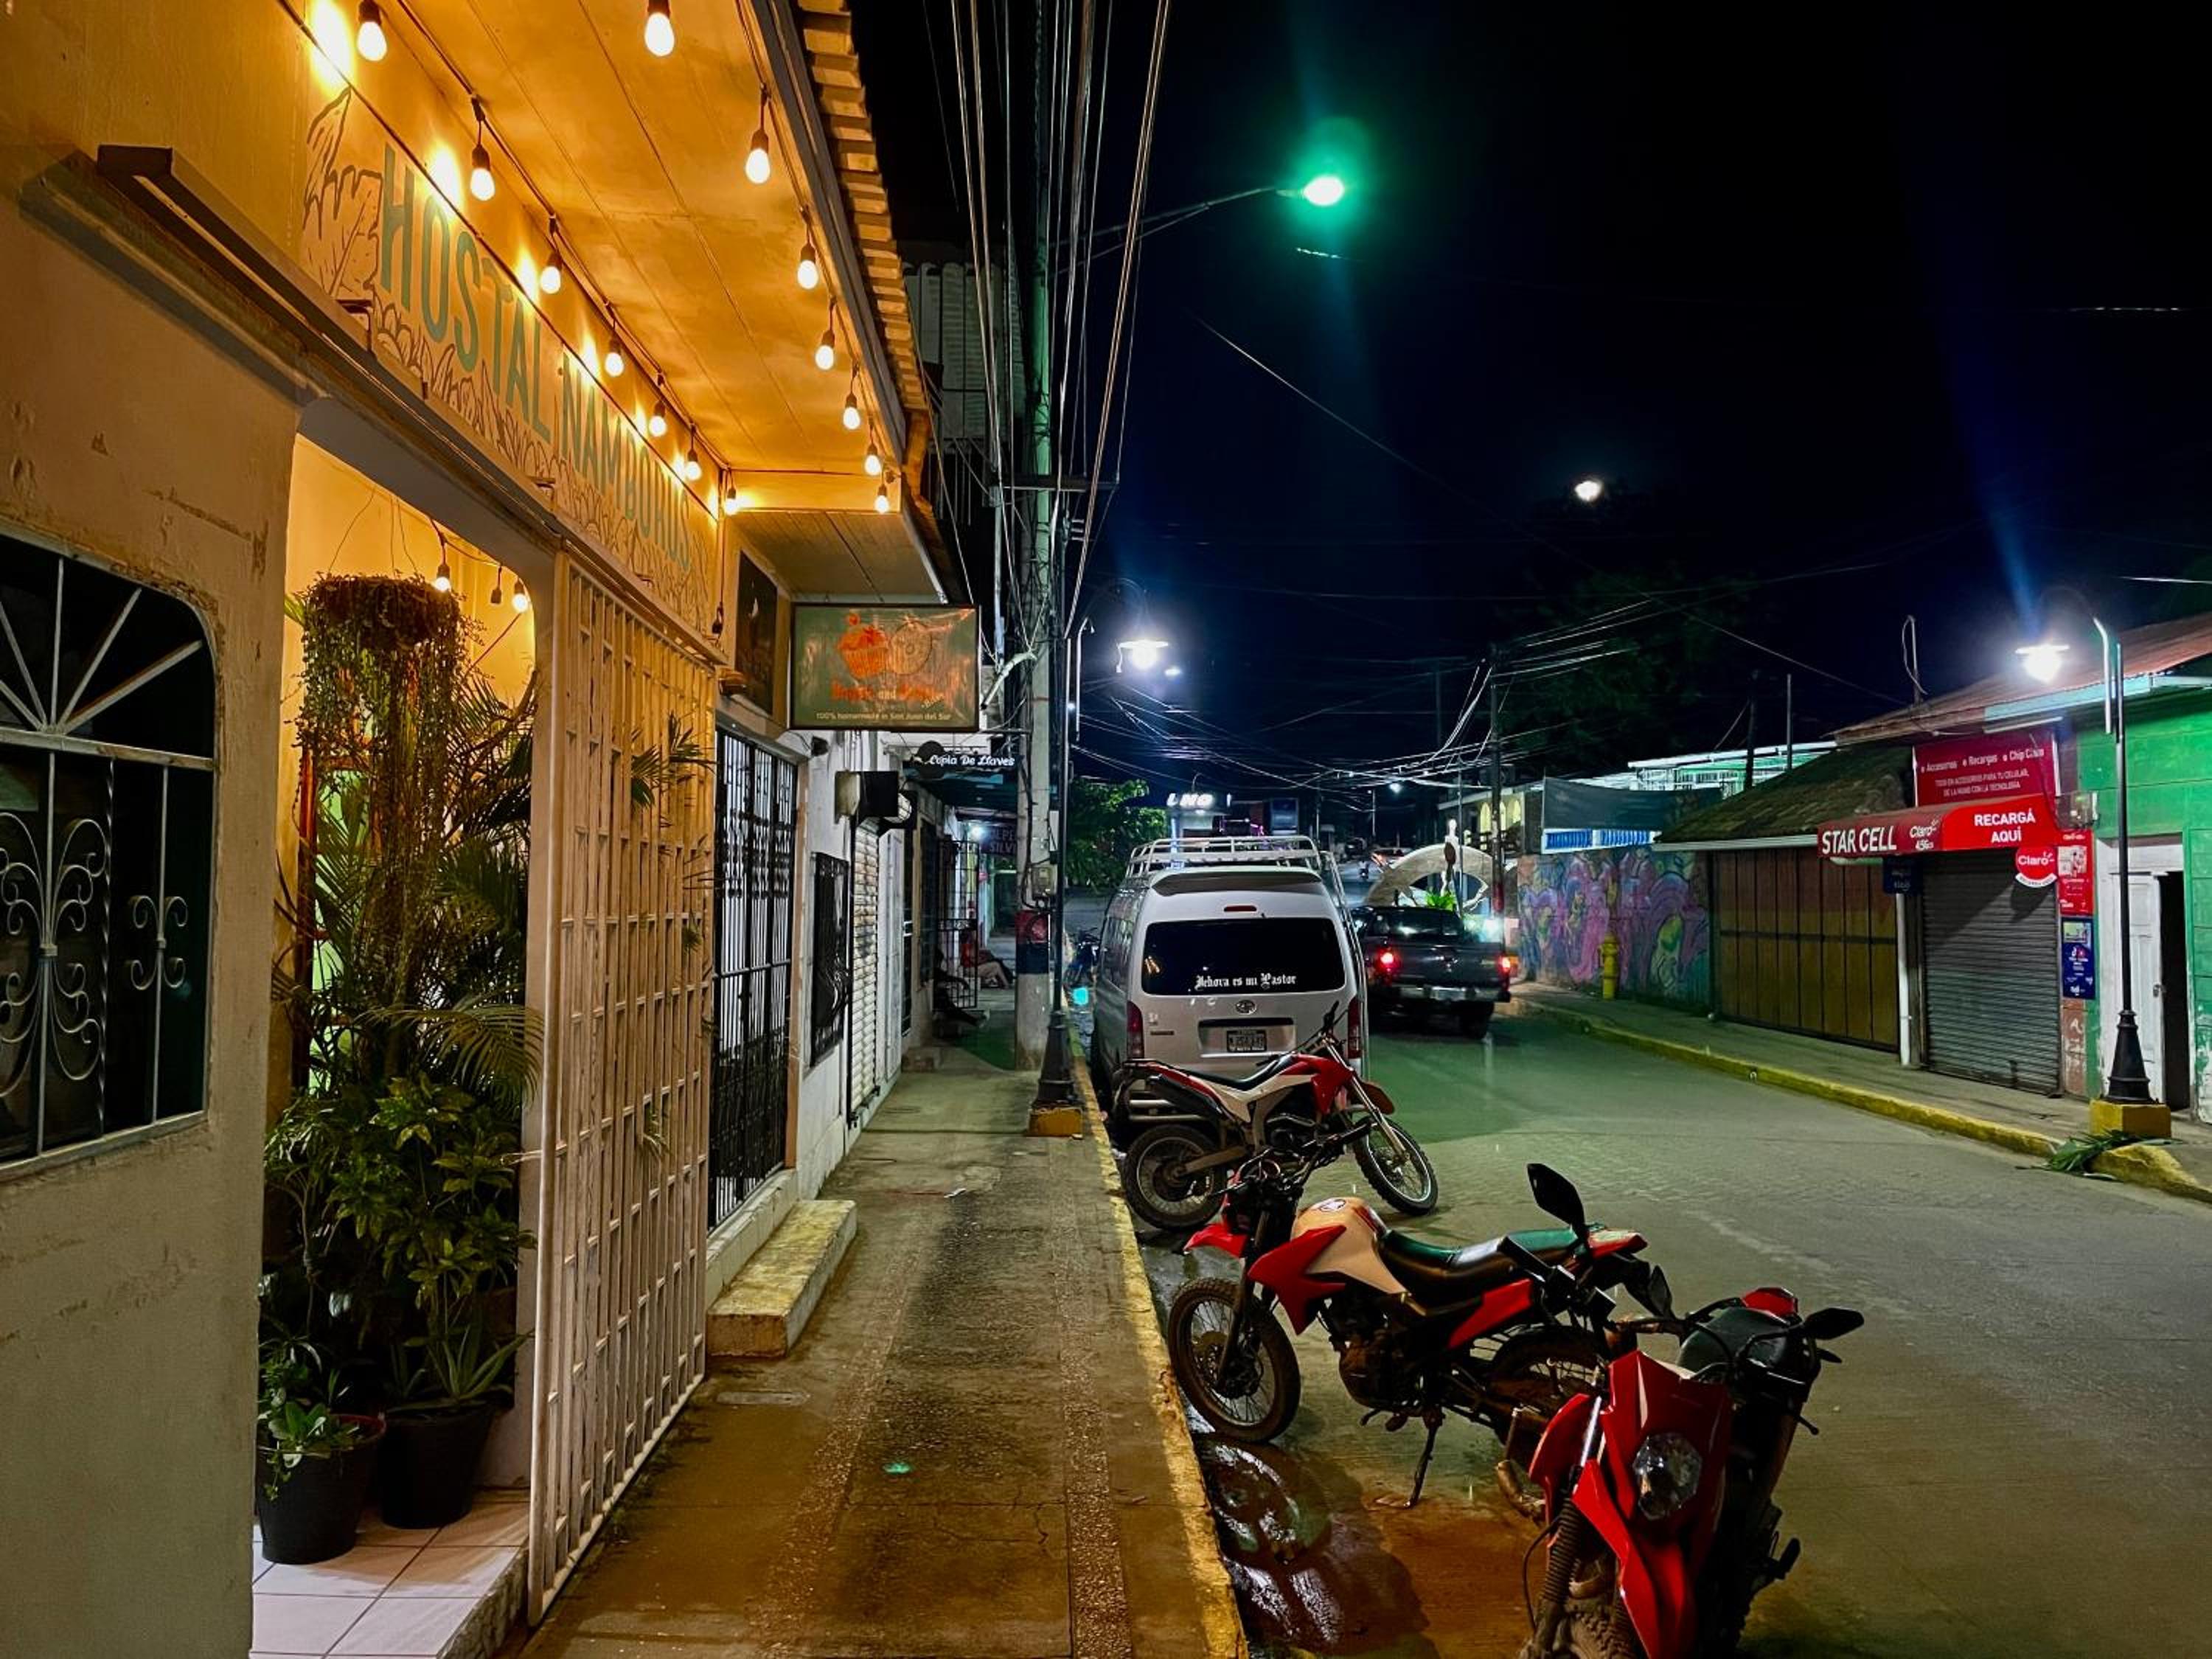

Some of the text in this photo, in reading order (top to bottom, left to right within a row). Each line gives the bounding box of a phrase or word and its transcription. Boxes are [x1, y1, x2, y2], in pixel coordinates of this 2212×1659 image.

[380, 142, 552, 444] HOSTAL
[1822, 825, 1897, 855] STAR CELL
[2017, 853, 2051, 866] Claro
